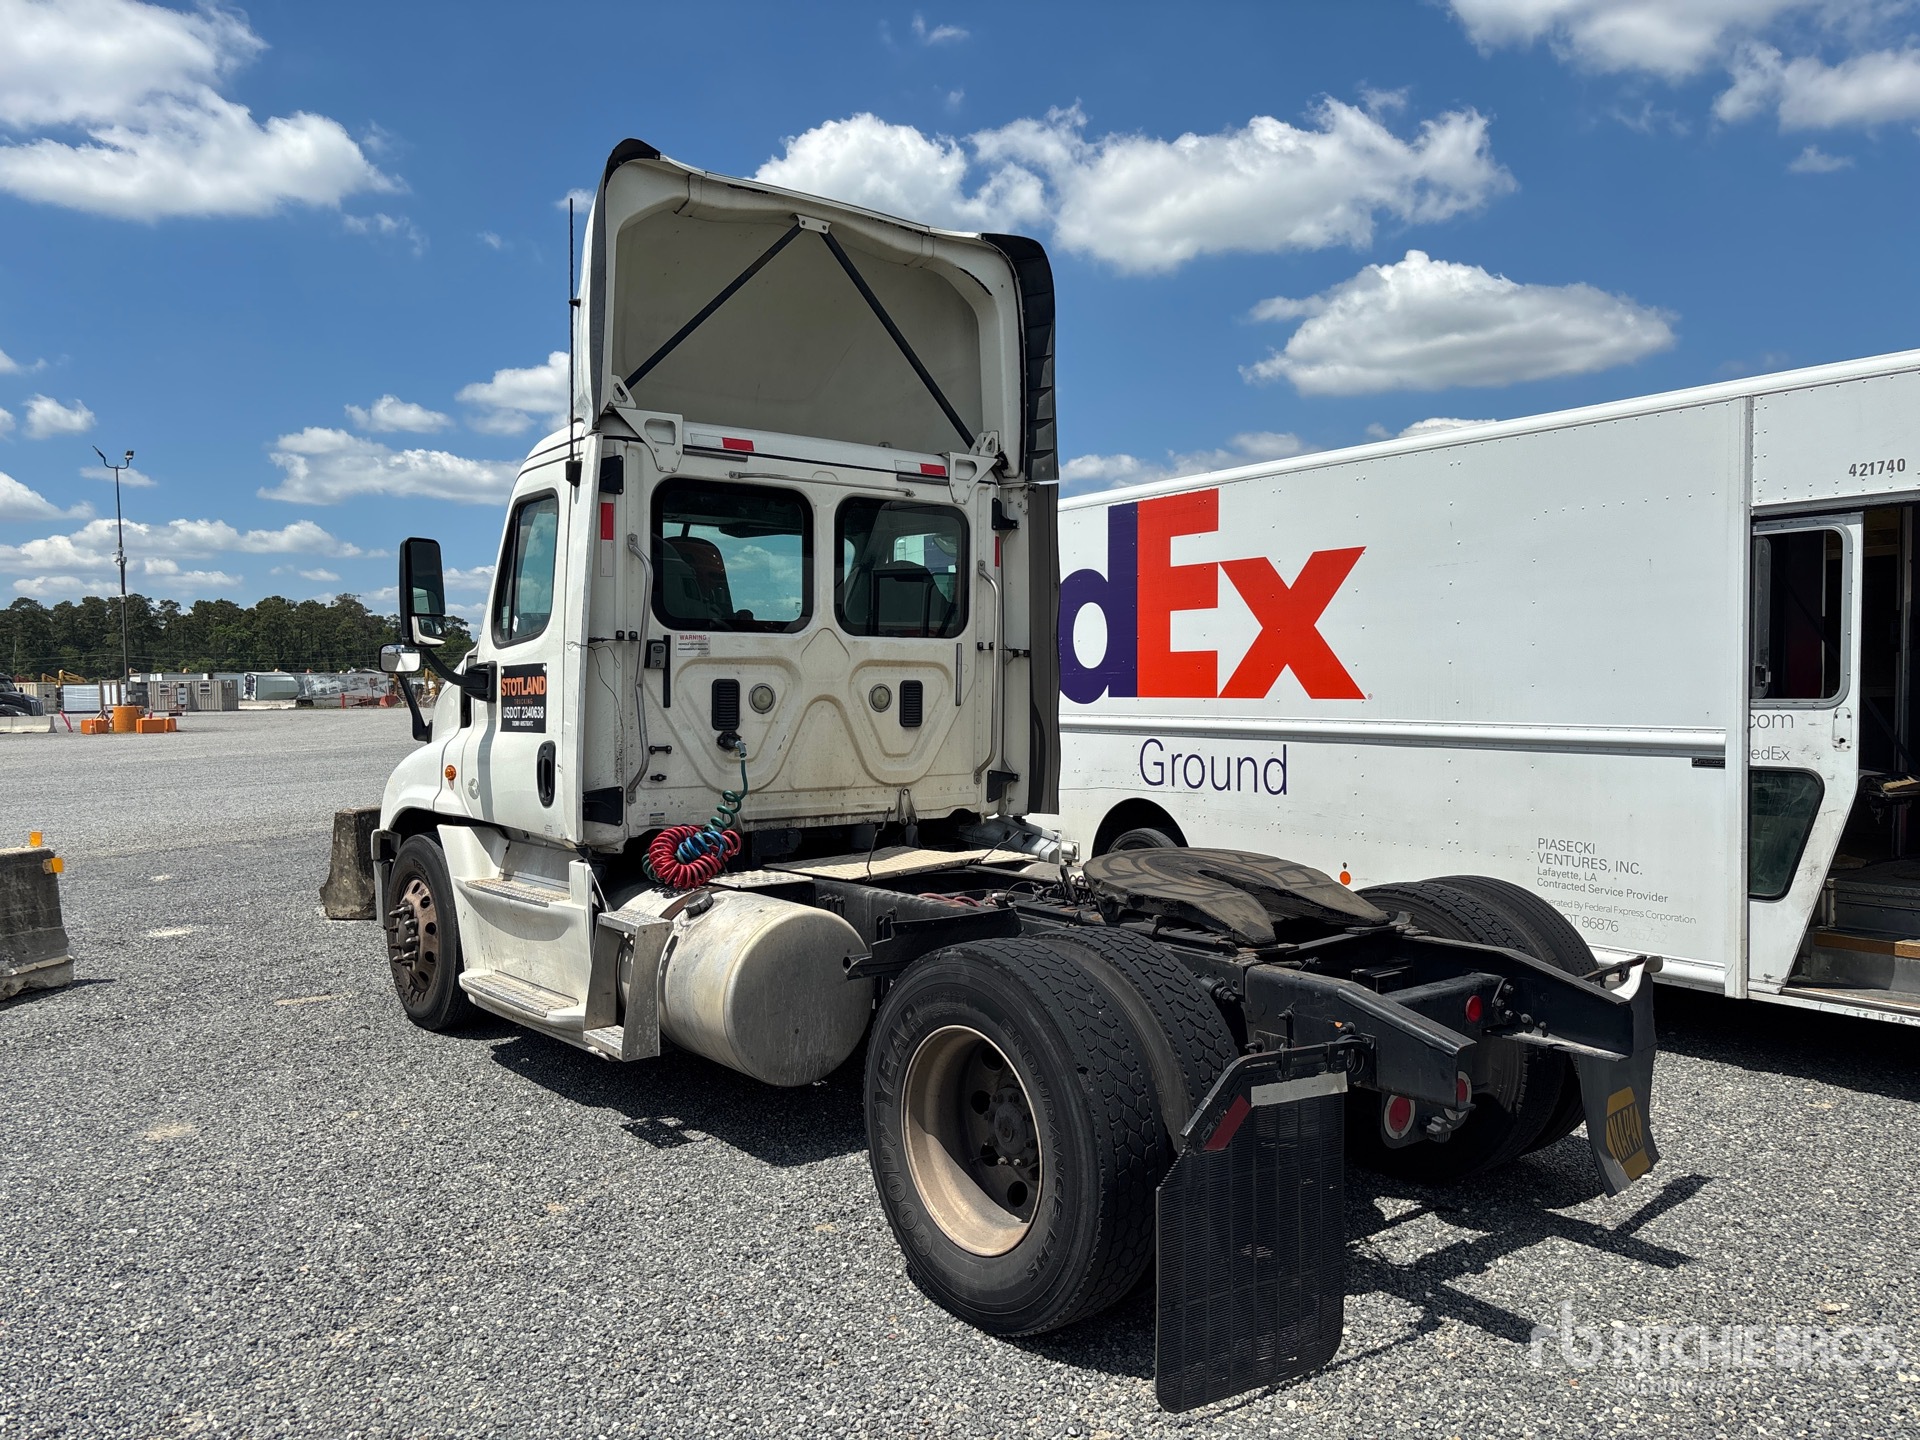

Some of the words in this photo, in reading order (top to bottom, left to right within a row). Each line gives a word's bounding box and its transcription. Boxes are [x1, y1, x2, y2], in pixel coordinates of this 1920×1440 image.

[1848, 458, 1906, 477] 421740
[501, 676, 546, 696] STOTLAND
[503, 706, 521, 719] USDOT
[1140, 738, 1287, 795] Ground
[1537, 837, 1596, 855] PIASECKI
[1537, 852, 1612, 873] VENTURES,
[1614, 860, 1643, 876] INC.
[1537, 866, 1582, 882] Lafayette,
[1584, 873, 1598, 882] LA
[1537, 877, 1586, 893] Contracted
[1588, 884, 1624, 898] Service
[1626, 888, 1669, 903] Provider
[1573, 901, 1584, 911] By
[1584, 902, 1613, 913] Federal
[1645, 910, 1697, 924] Corporation
[1581, 916, 1619, 932] 86876
[998, 1018, 1064, 1218] ENDURANCE
[1607, 1103, 1643, 1163] NAPA
